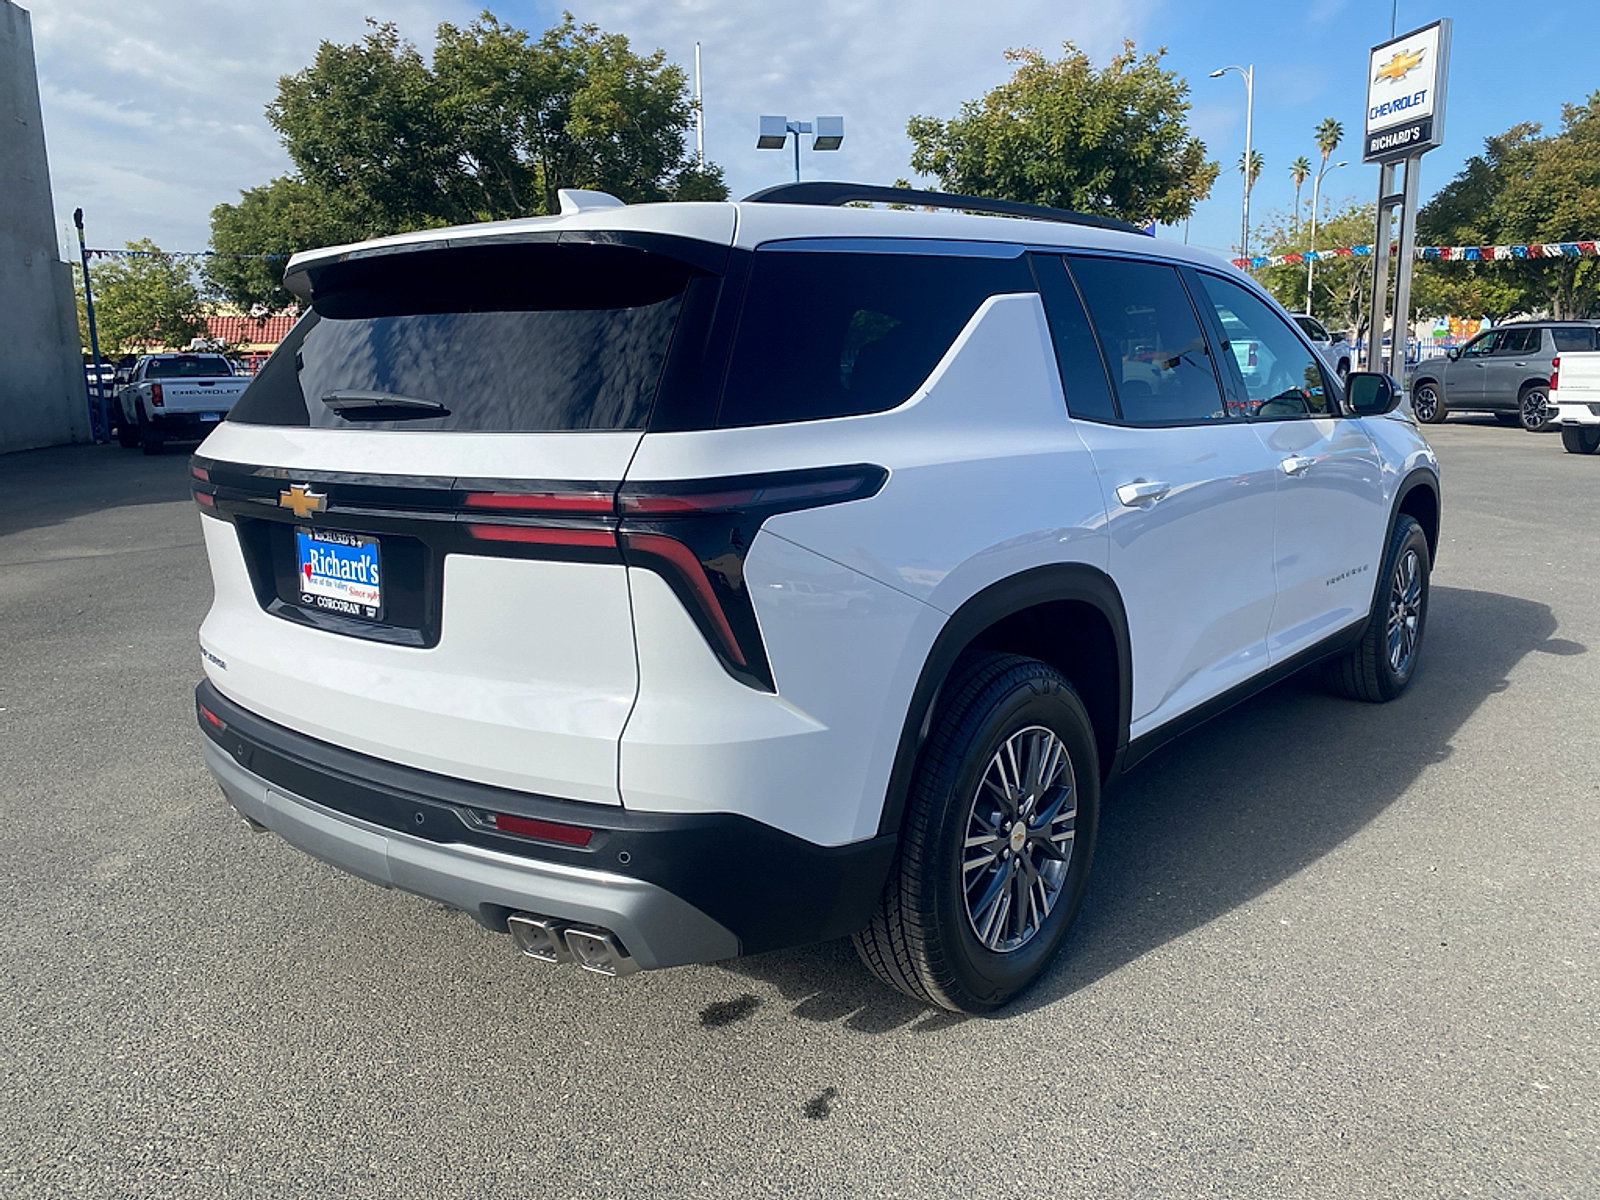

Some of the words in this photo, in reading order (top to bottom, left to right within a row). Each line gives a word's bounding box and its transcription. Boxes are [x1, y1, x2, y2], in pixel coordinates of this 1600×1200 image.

[1369, 89, 1427, 120] CHEVROLET
[1370, 126, 1420, 152] RICHARD'S
[172, 388, 240, 396] CHEVROLET
[309, 547, 379, 584] Richard's
[317, 596, 360, 614] CORCORAN
